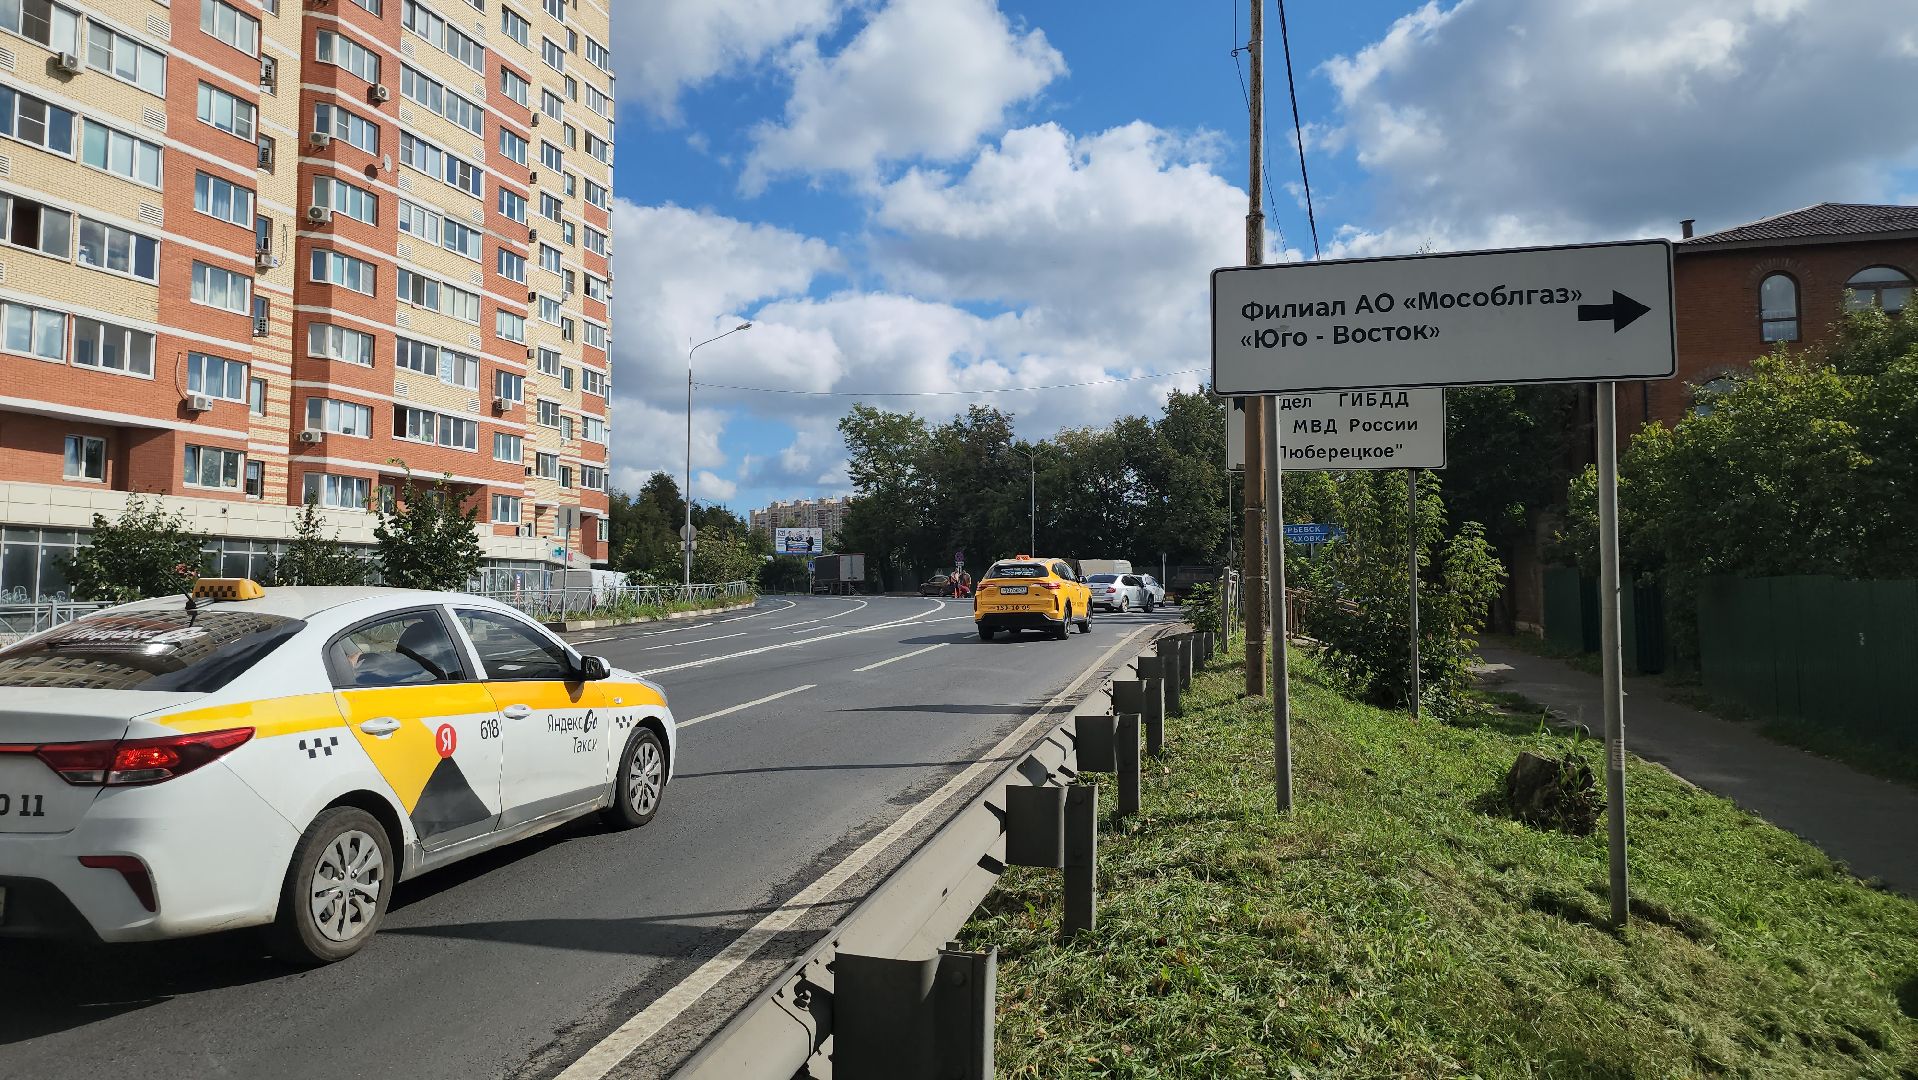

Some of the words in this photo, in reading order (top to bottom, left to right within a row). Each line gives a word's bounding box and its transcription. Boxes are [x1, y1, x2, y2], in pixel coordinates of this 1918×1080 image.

[1241, 300, 1346, 322] Филиал
[1354, 292, 1395, 315] АО
[1403, 284, 1582, 311] «Мособлгаз»
[1240, 328, 1308, 349] «Юго
[1333, 324, 1440, 345] Восток»
[1280, 397, 1312, 410] дел
[1339, 391, 1409, 409] ГИБДД
[1292, 418, 1338, 434] МВД
[1349, 418, 1418, 432] России
[480, 718, 500, 740] 618
[547, 713, 584, 734] Яндекс
[584, 709, 598, 733] Go
[573, 736, 598, 754] Такси
[19, 794, 45, 817] 11
